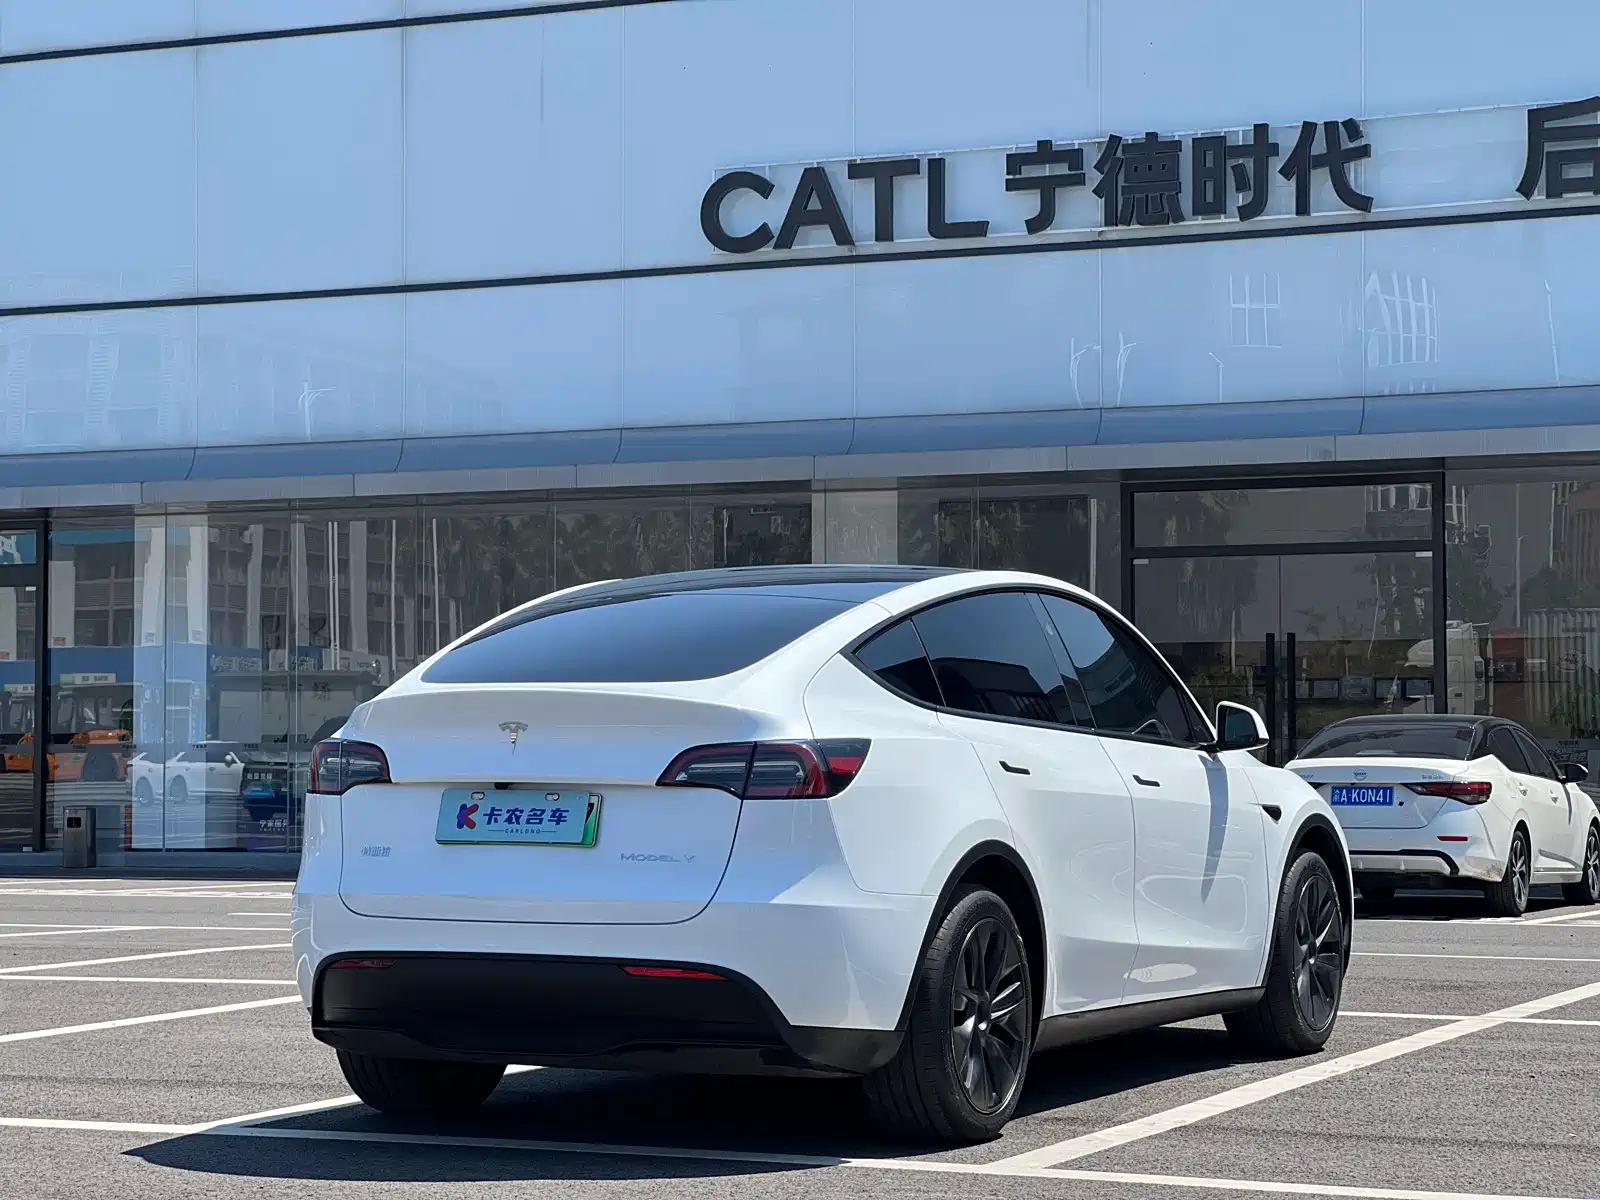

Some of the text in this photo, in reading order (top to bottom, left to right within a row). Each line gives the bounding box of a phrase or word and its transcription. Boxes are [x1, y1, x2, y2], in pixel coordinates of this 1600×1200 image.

[700, 96, 1600, 254] CATL 宁德时代 后
[482, 806, 570, 826] 卡农名车
[620, 852, 697, 864] MODEL Y
